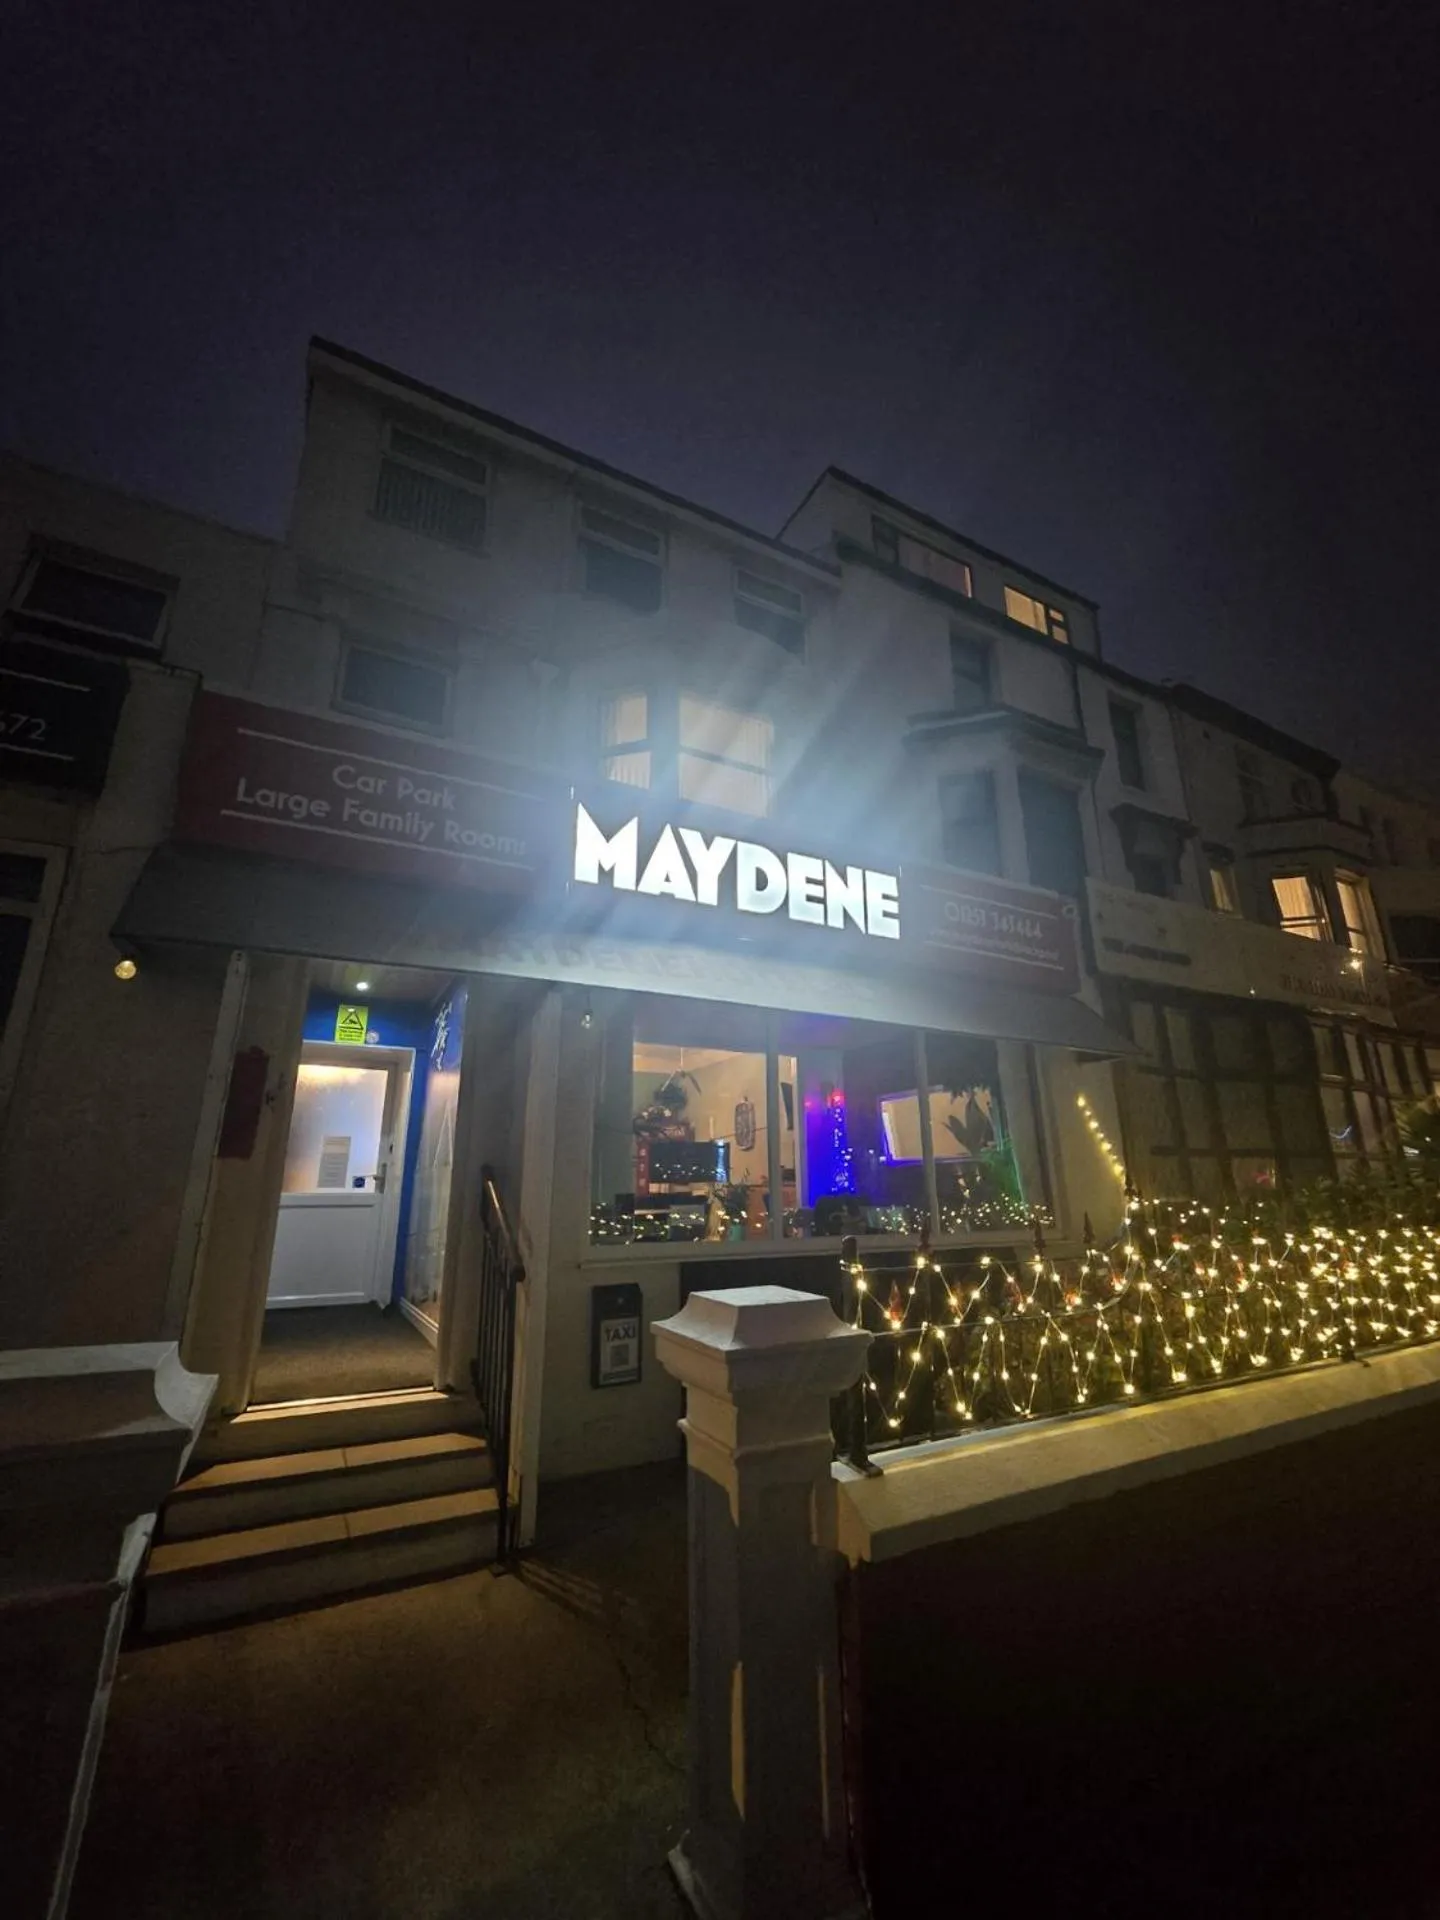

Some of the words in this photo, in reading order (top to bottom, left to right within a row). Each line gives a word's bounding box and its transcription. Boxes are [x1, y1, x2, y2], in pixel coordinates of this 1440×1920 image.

[235, 776, 331, 819] Large
[342, 797, 436, 842] Family
[331, 763, 387, 796] Car
[396, 777, 458, 813] Park
[574, 801, 900, 940] MAYDENE
[604, 1323, 636, 1342] TAXI
